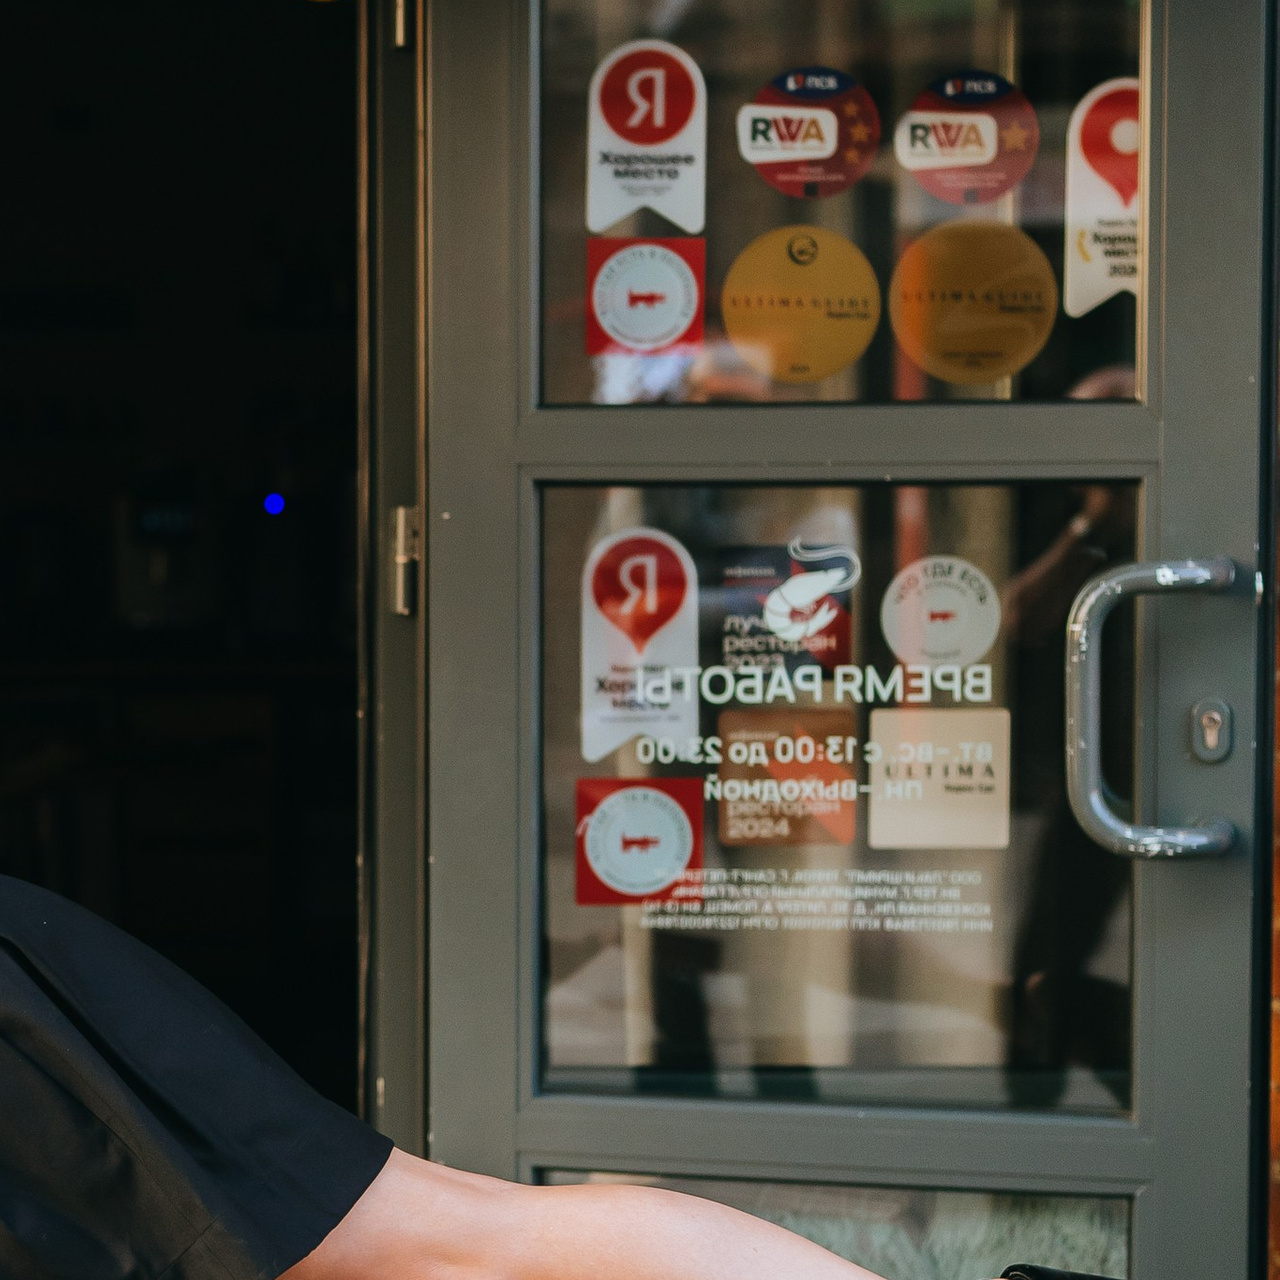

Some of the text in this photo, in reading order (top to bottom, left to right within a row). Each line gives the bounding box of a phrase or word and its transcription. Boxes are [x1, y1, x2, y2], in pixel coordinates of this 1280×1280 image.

[626, 68, 665, 128] Я
[751, 116, 827, 145] RWA
[909, 120, 986, 150] RWA
[598, 151, 696, 167] Хорошее
[613, 167, 679, 180] место
[619, 556, 658, 614] Я
[885, 764, 996, 779] ULTIMA
